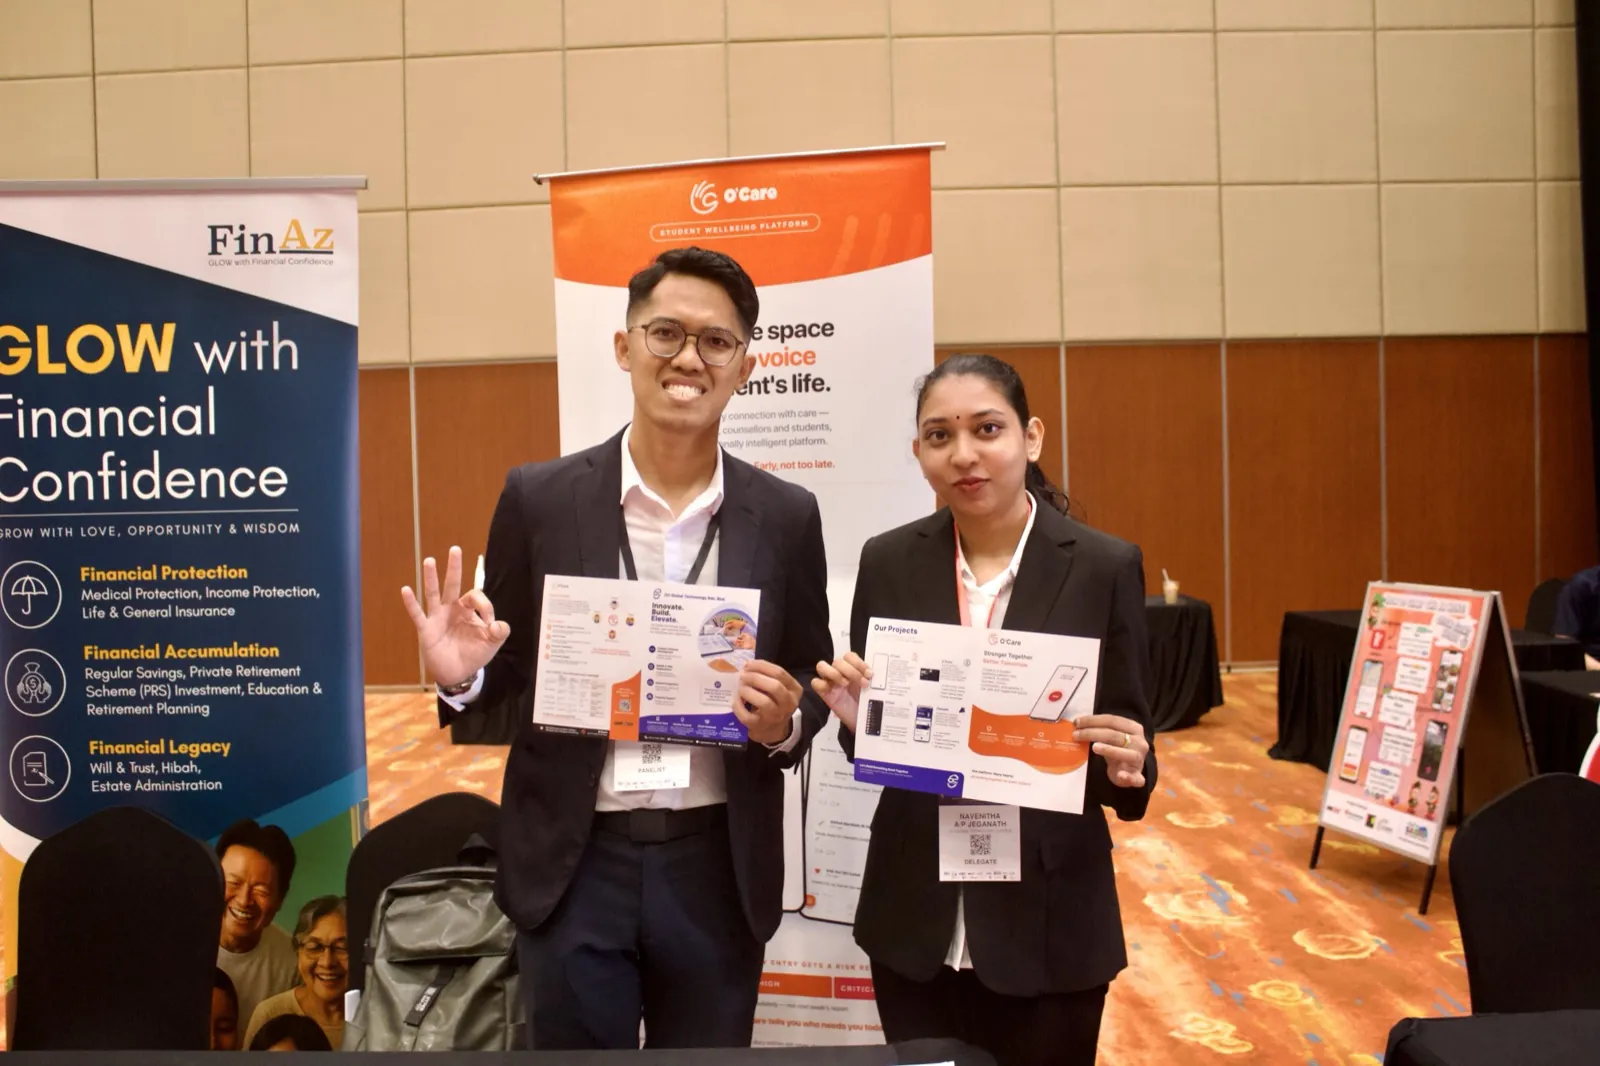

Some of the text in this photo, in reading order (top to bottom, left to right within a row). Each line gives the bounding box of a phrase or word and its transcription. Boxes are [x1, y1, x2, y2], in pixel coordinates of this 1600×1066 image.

[723, 186, 778, 203] O'Care
[660, 220, 808, 237] STUDENT WELLBEING PLATFORM
[207, 218, 334, 255] FinAz
[768, 322, 834, 343] space
[0, 321, 298, 375] GLOW with
[758, 347, 816, 367] voice
[792, 373, 831, 393] life.
[728, 411, 776, 421] connection
[778, 410, 796, 418] with
[798, 410, 817, 418] care
[723, 422, 832, 435] counsellors and students,
[746, 438, 787, 448] intelligent
[789, 436, 828, 447] platform.
[780, 461, 795, 469] not
[798, 460, 813, 469] too
[815, 459, 835, 468] late.
[0, 450, 288, 502] Confidence
[40, 527, 73, 538] WITH
[80, 526, 121, 538] LOVE,
[127, 524, 222, 536] OPPORTUNITY
[229, 524, 237, 534] &
[243, 523, 300, 534] WISDOM
[80, 565, 248, 581] Financial Protection
[82, 586, 320, 600] Medical Protection, Income Protection,
[82, 605, 235, 619] Life & General Insurance
[652, 602, 684, 610] Innovate.
[874, 623, 918, 635] Our Projects
[1000, 638, 1021, 646] O'Care
[84, 642, 279, 660] Financial Accumulation
[983, 650, 1033, 661] Stronger Together
[85, 665, 301, 682] Regular Savings, Private Retirement
[86, 682, 322, 700] Scheme (PRS) Investment, Education &
[87, 702, 210, 717] Retirement Planning
[89, 739, 231, 758] Financial Legacy
[90, 760, 201, 774] Will & Trust, Hibah,
[92, 779, 222, 792] Estate Administration
[769, 1018, 785, 1026] tells
[787, 1019, 802, 1028] you
[802, 1020, 820, 1028] who
[821, 1021, 846, 1030] needs
[848, 1023, 863, 1032] you
